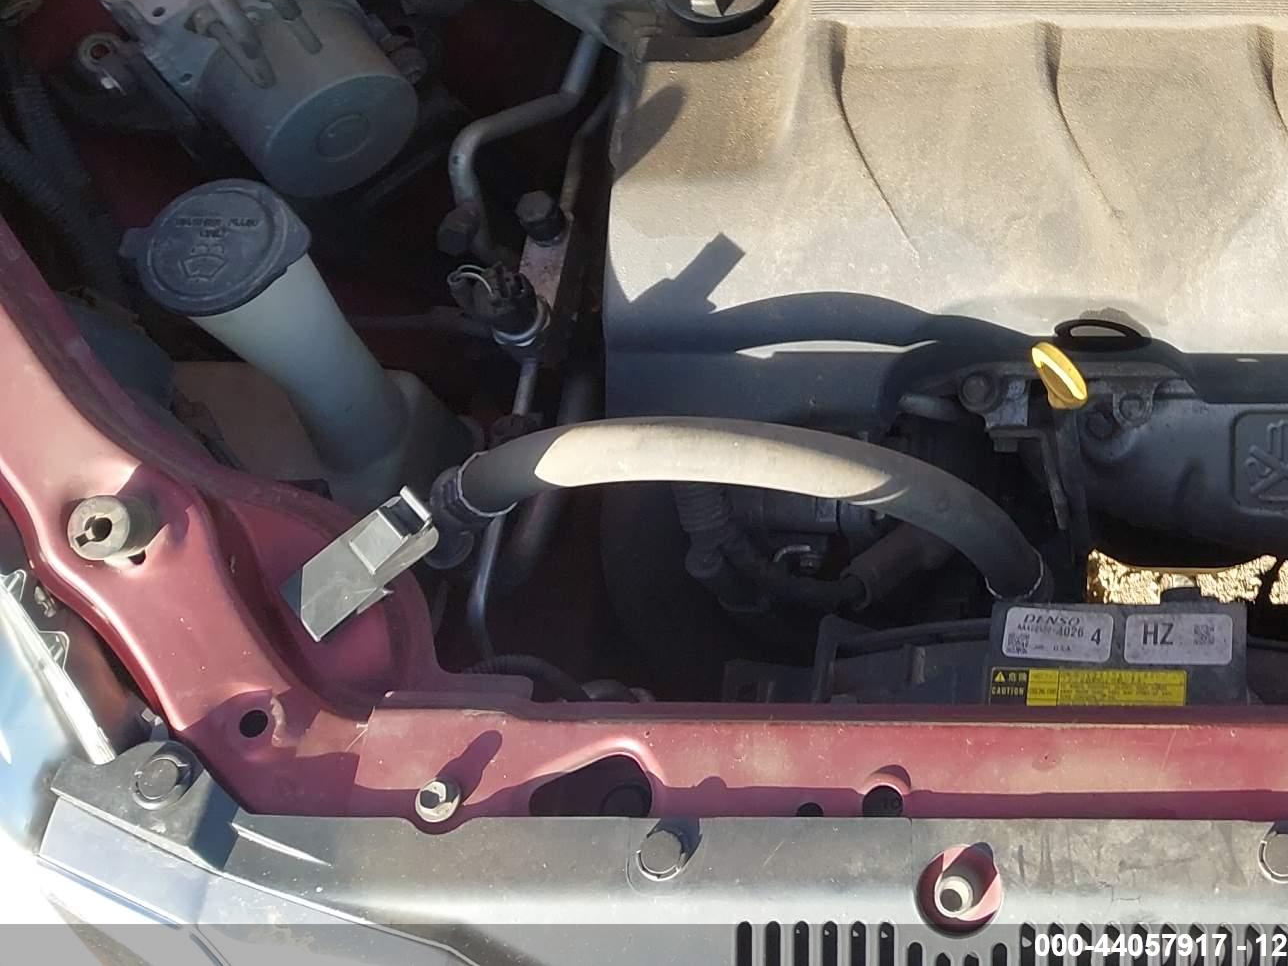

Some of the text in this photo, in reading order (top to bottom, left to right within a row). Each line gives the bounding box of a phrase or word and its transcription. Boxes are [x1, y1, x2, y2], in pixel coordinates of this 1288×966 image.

[1024, 613, 1080, 626] DENSO
[1090, 627, 1102, 646] 4
[1142, 622, 1174, 646] HZ
[991, 686, 1024, 696] CAUTION
